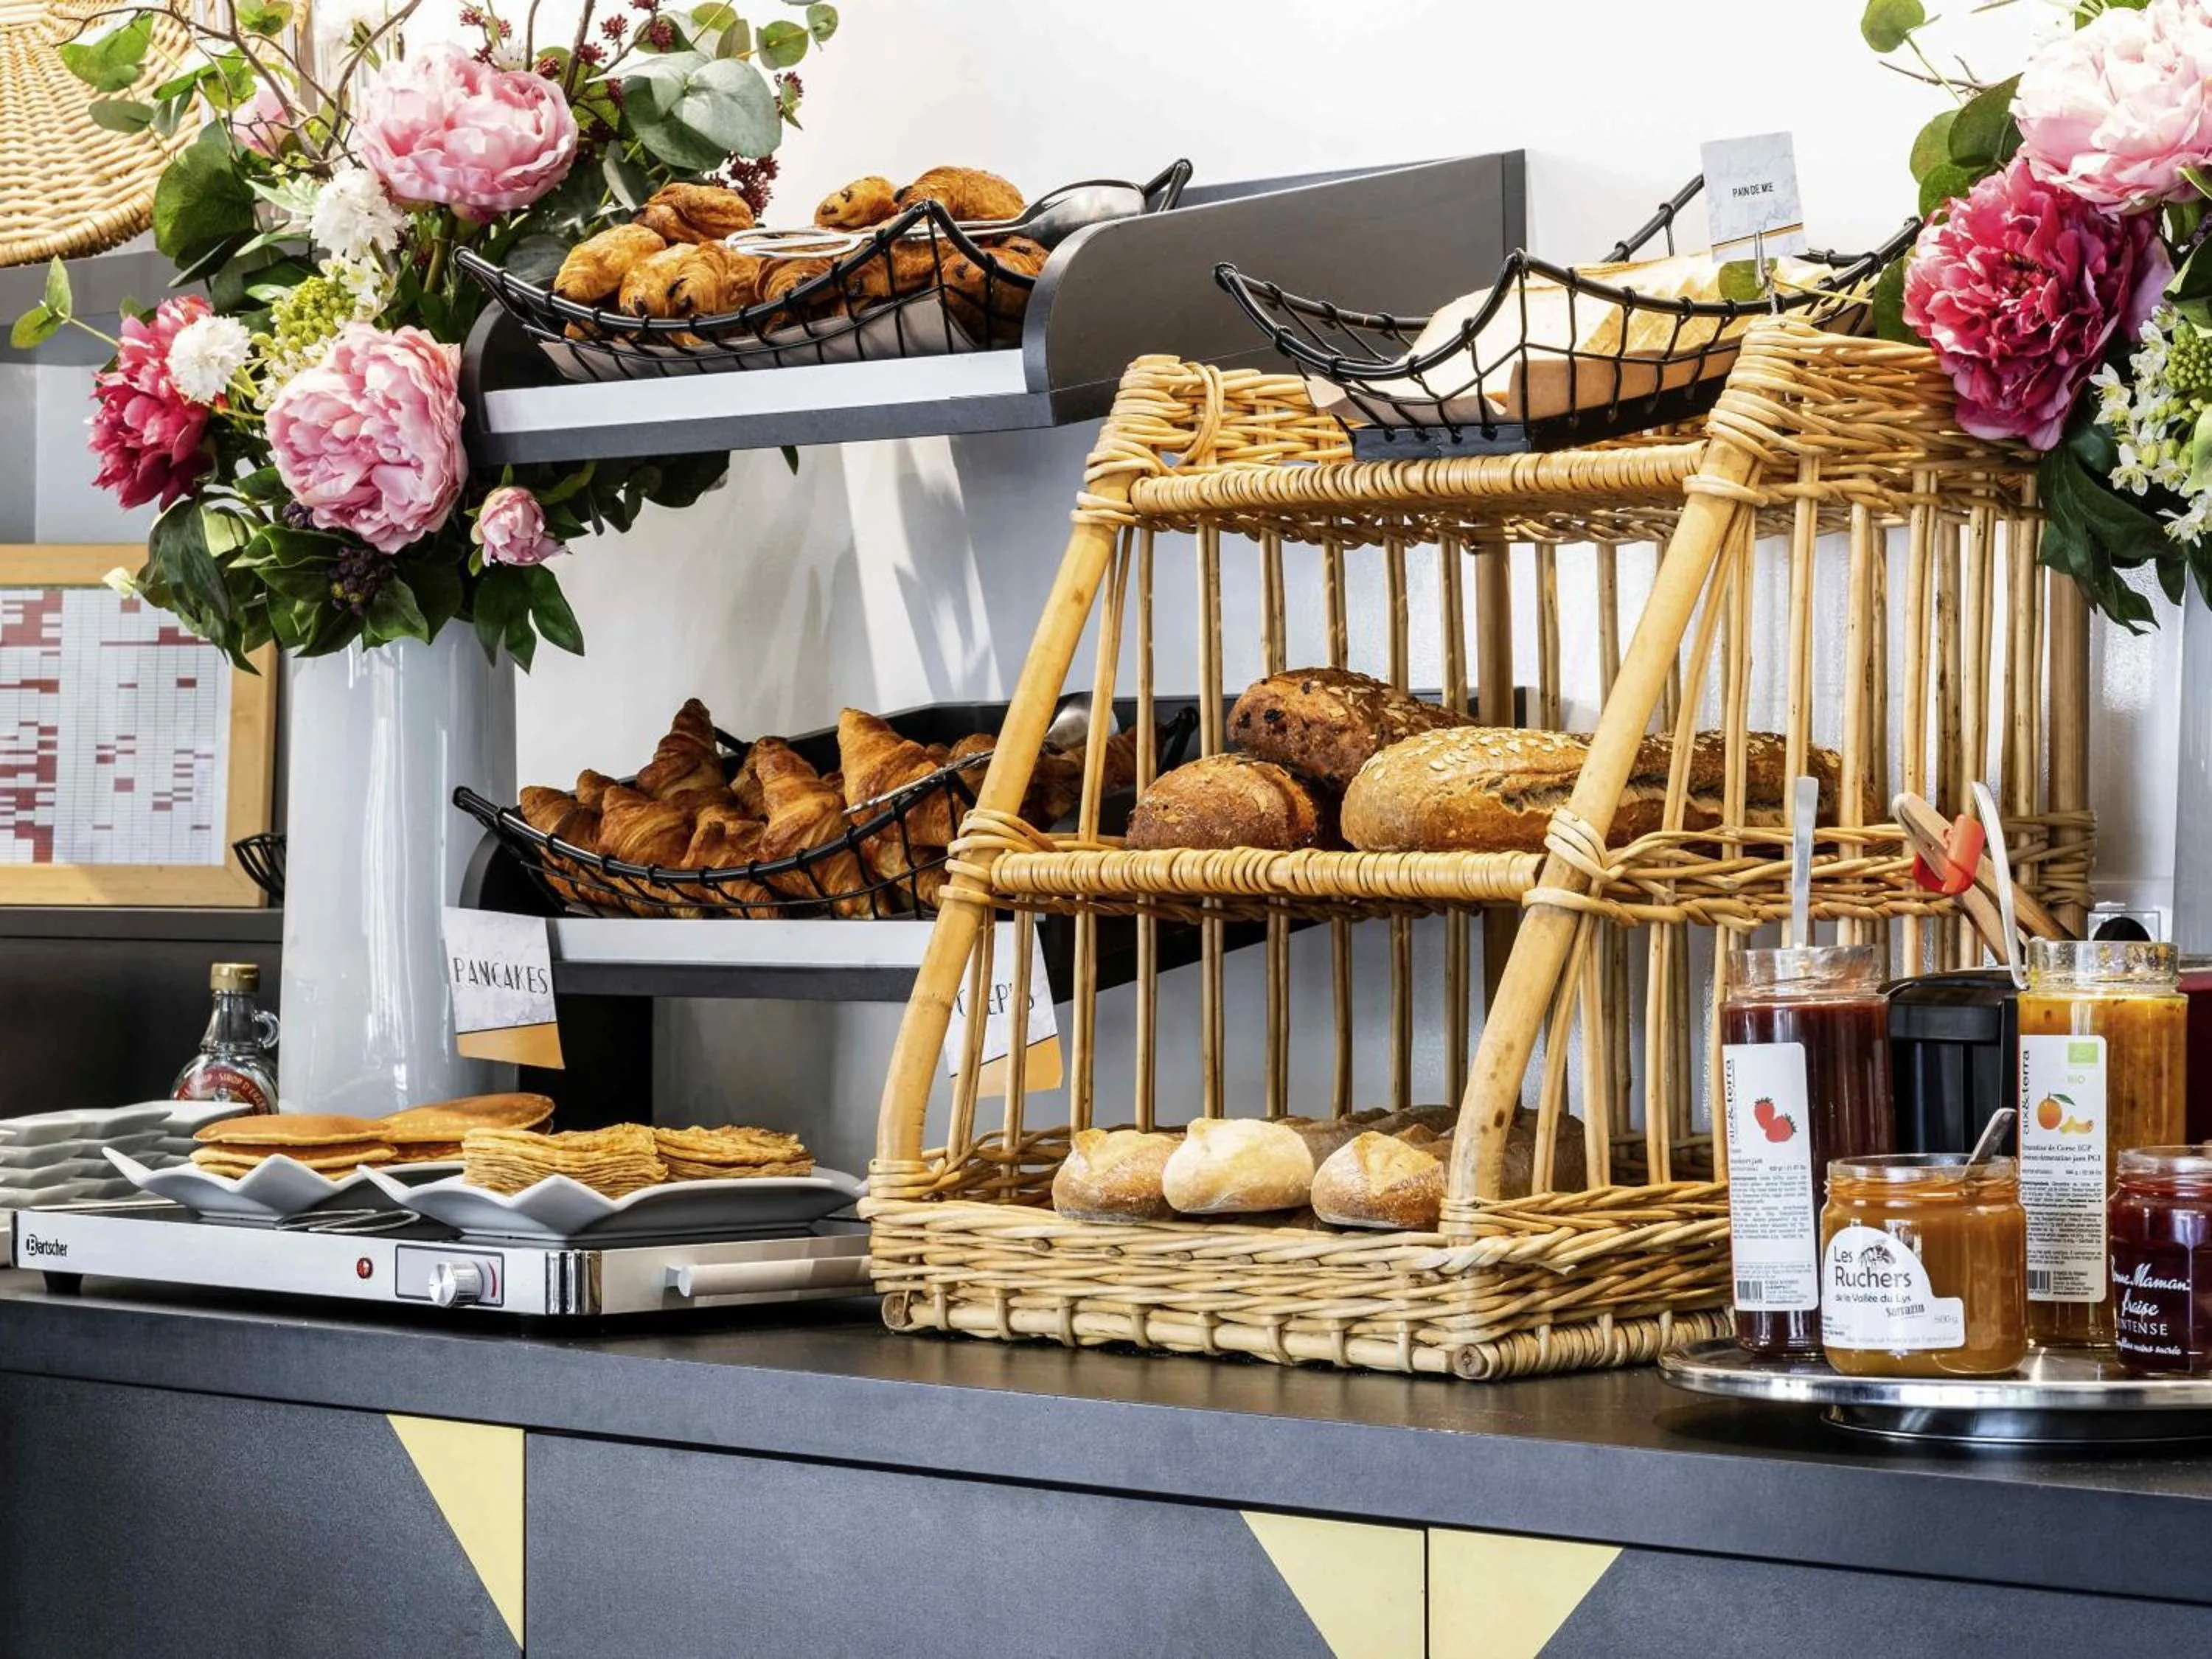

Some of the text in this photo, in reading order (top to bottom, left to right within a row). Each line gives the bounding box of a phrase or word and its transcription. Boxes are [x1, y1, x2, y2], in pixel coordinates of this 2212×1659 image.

[1732, 182, 1774, 198] PAIN DE MIE
[453, 957, 549, 994] PANCAKES
[26, 1234, 68, 1256] Bartscher
[1834, 1246, 1852, 1263] Les
[1835, 1266, 1912, 1288] Ruchers
[2131, 1263, 2191, 1291] Maman
[1852, 1293, 1878, 1304] Vallée
[1881, 1293, 1893, 1303] du
[1896, 1293, 1911, 1304] Lys
[2121, 1288, 2159, 1317] fraise
